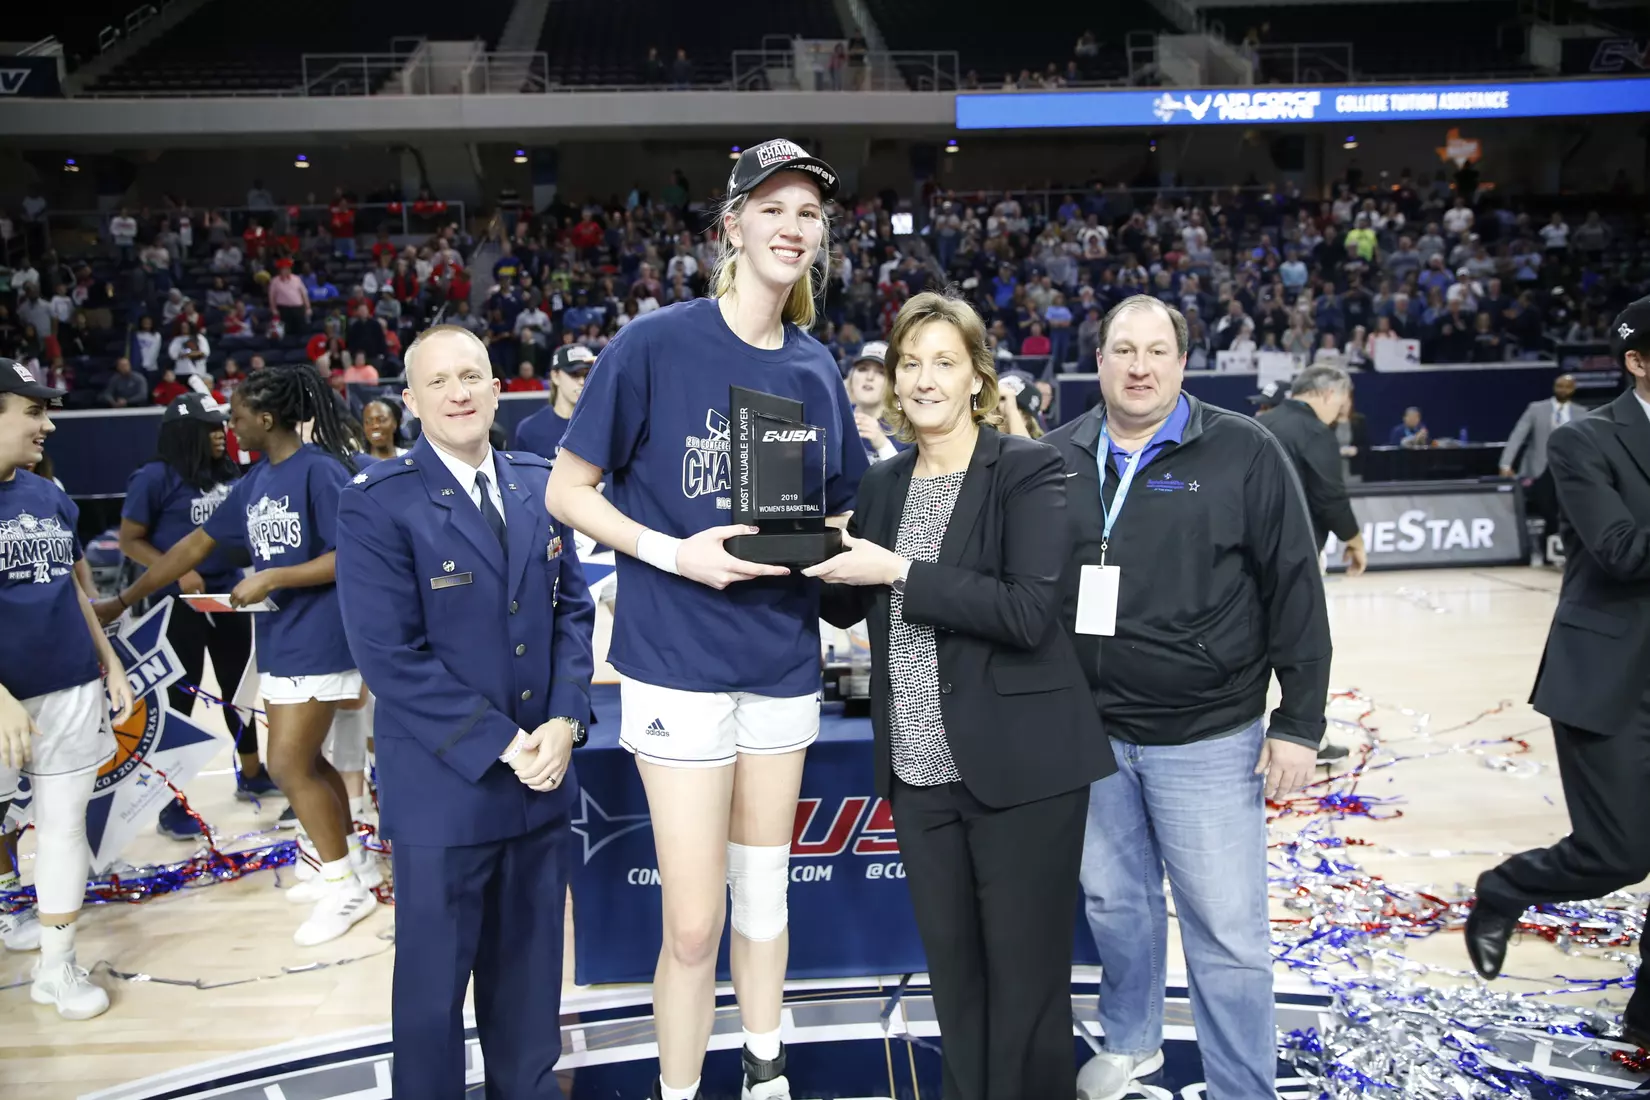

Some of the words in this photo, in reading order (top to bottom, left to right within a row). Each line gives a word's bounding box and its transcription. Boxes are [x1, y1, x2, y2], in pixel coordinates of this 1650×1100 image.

[1212, 92, 1250, 108] AIR
[1252, 91, 1321, 107] FORCE
[1335, 94, 1389, 113] COLLEGE
[1390, 92, 1437, 111] TUITION
[1438, 91, 1510, 110] ASSISTANCE
[740, 407, 749, 441] PLAYER
[740, 443, 749, 486] VALUABLE
[740, 487, 749, 512] MOST
[759, 505, 785, 513] WOMEN'S
[786, 504, 820, 512] BASKETBALL
[8, 570, 31, 580] RICE
[142, 707, 158, 744] TEXAS
[645, 729, 670, 738] adidas
